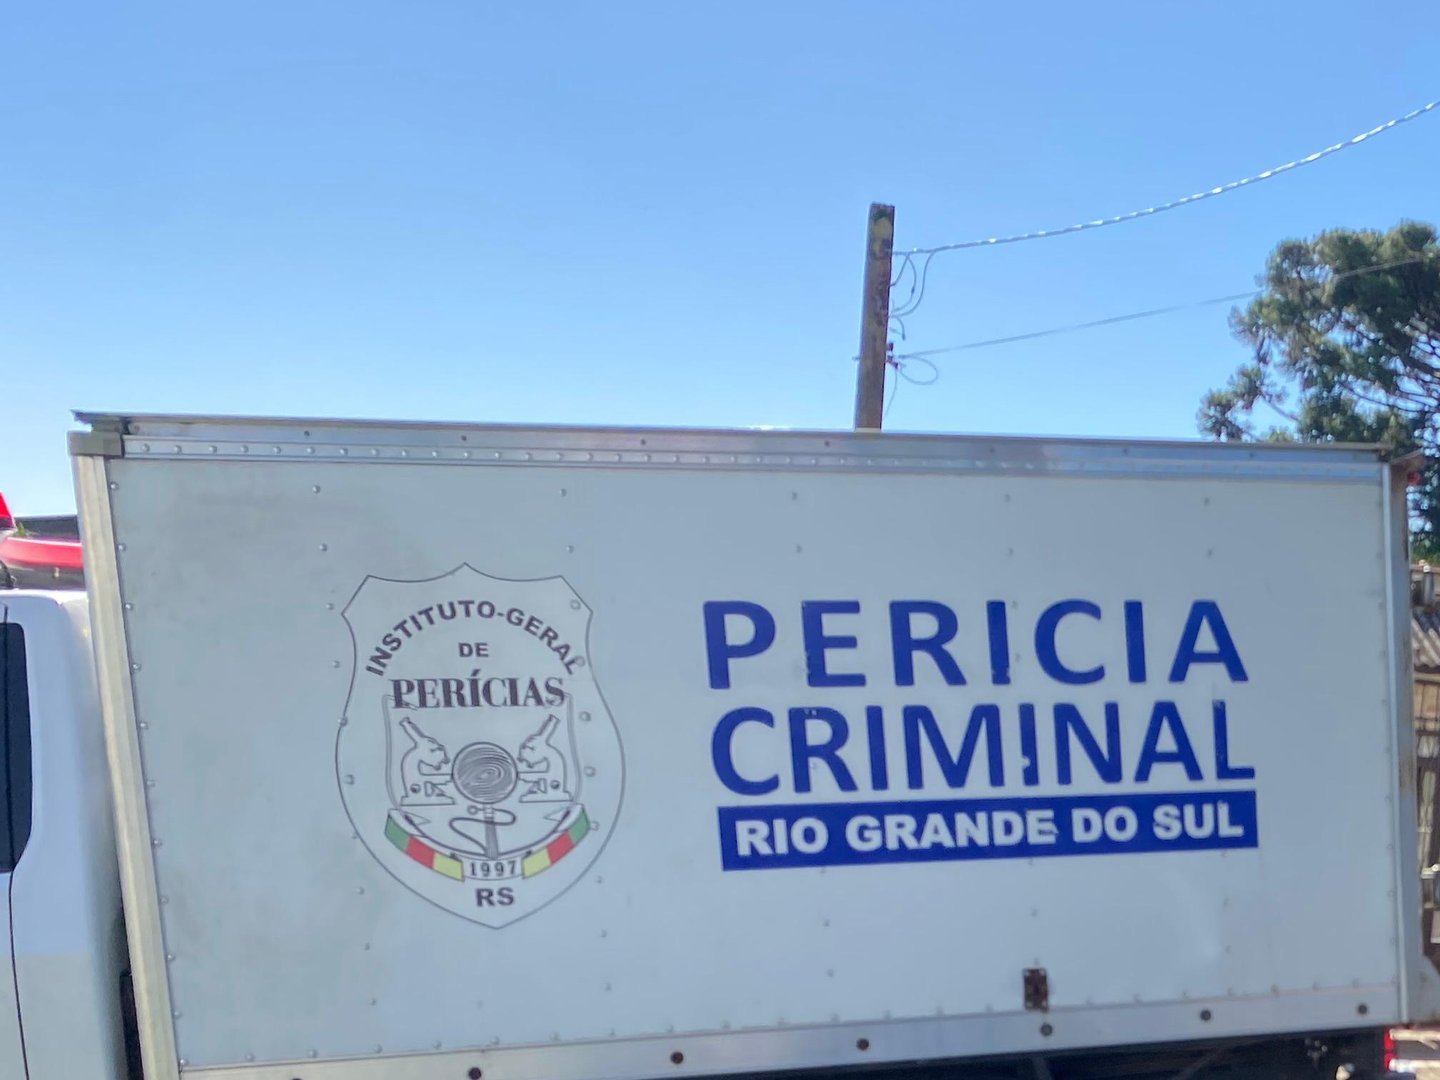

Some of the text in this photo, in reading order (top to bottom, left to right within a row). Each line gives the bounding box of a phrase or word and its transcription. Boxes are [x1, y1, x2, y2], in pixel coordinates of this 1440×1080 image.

[458, 642, 489, 658] DE
[702, 598, 1249, 690] PERICIA
[390, 669, 567, 709] PERÍCIAS
[711, 700, 1256, 796] CRIMINAL
[735, 801, 1244, 856] RIO GRANDE DO SUL
[469, 860, 517, 877] 1997
[475, 886, 515, 907] RS
